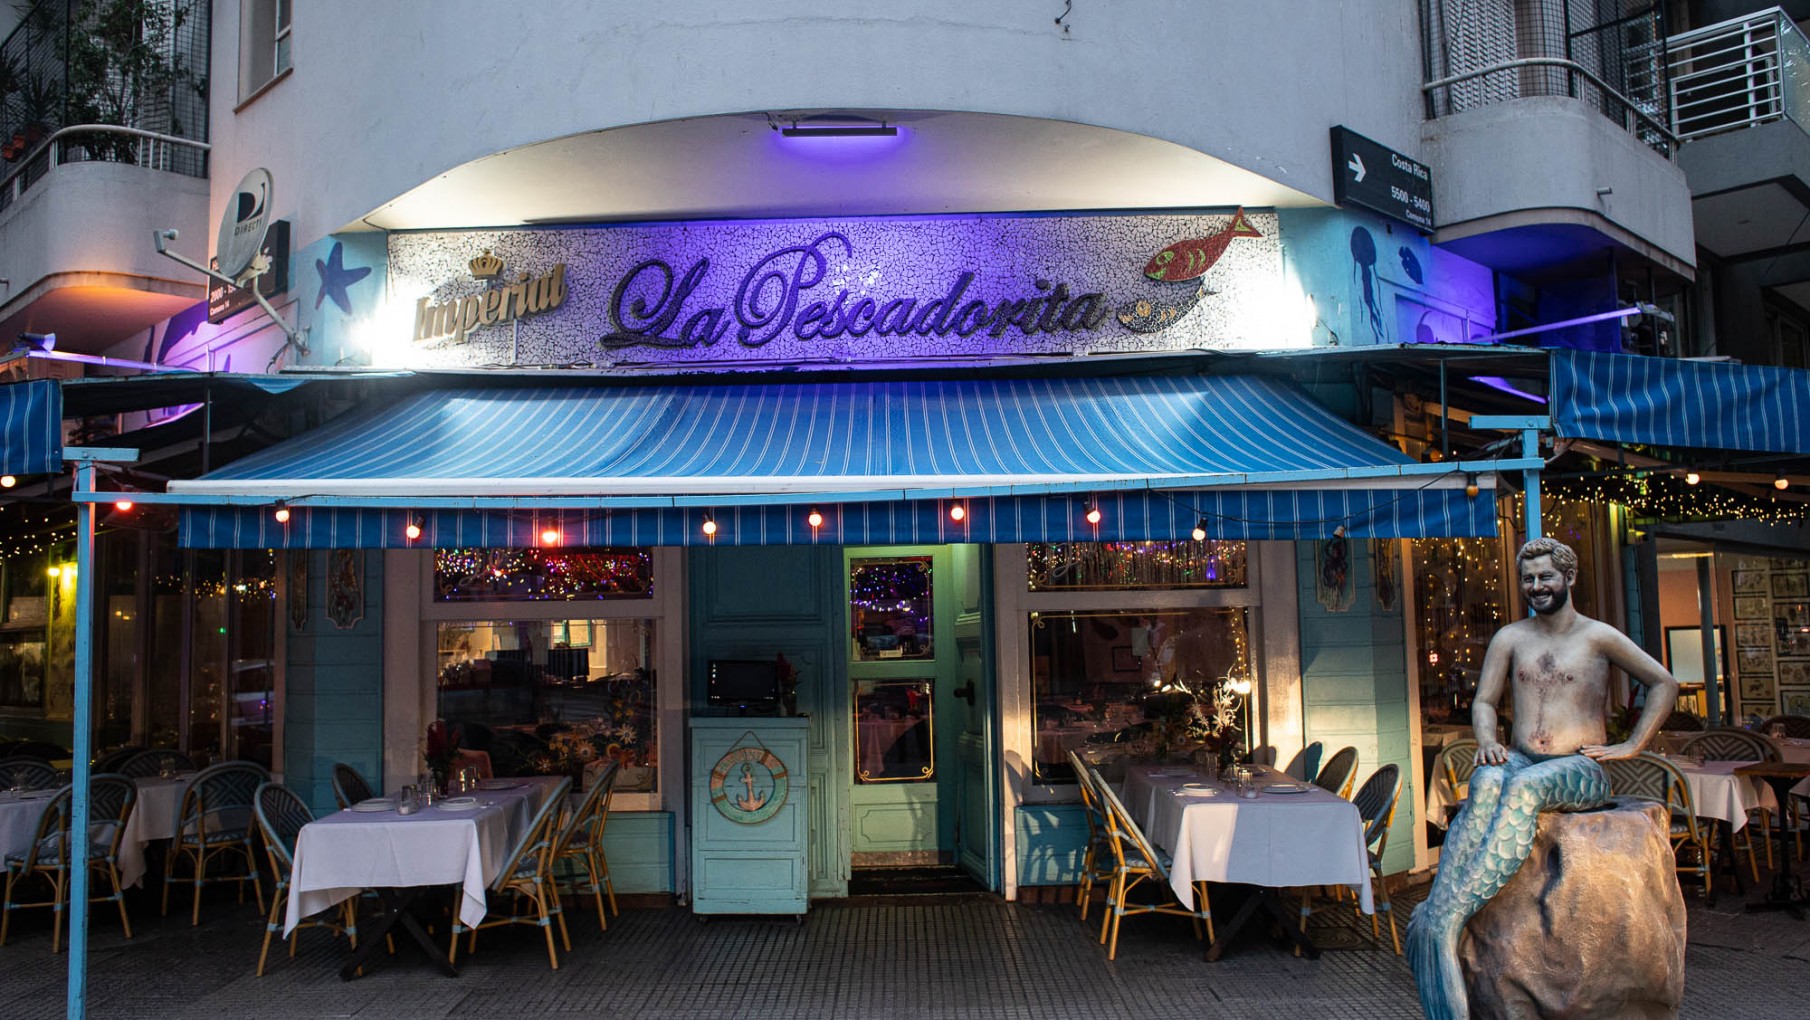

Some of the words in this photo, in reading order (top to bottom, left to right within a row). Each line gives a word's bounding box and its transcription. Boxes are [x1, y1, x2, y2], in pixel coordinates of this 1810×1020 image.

[1391, 153, 1412, 173] Costa
[1413, 163, 1428, 180] Rica
[1391, 185, 1409, 204] 5500
[1413, 195, 1431, 213] 5400
[413, 263, 567, 345] Imperial
[601, 257, 730, 349] La
[734, 231, 1107, 347] Pescadorita
